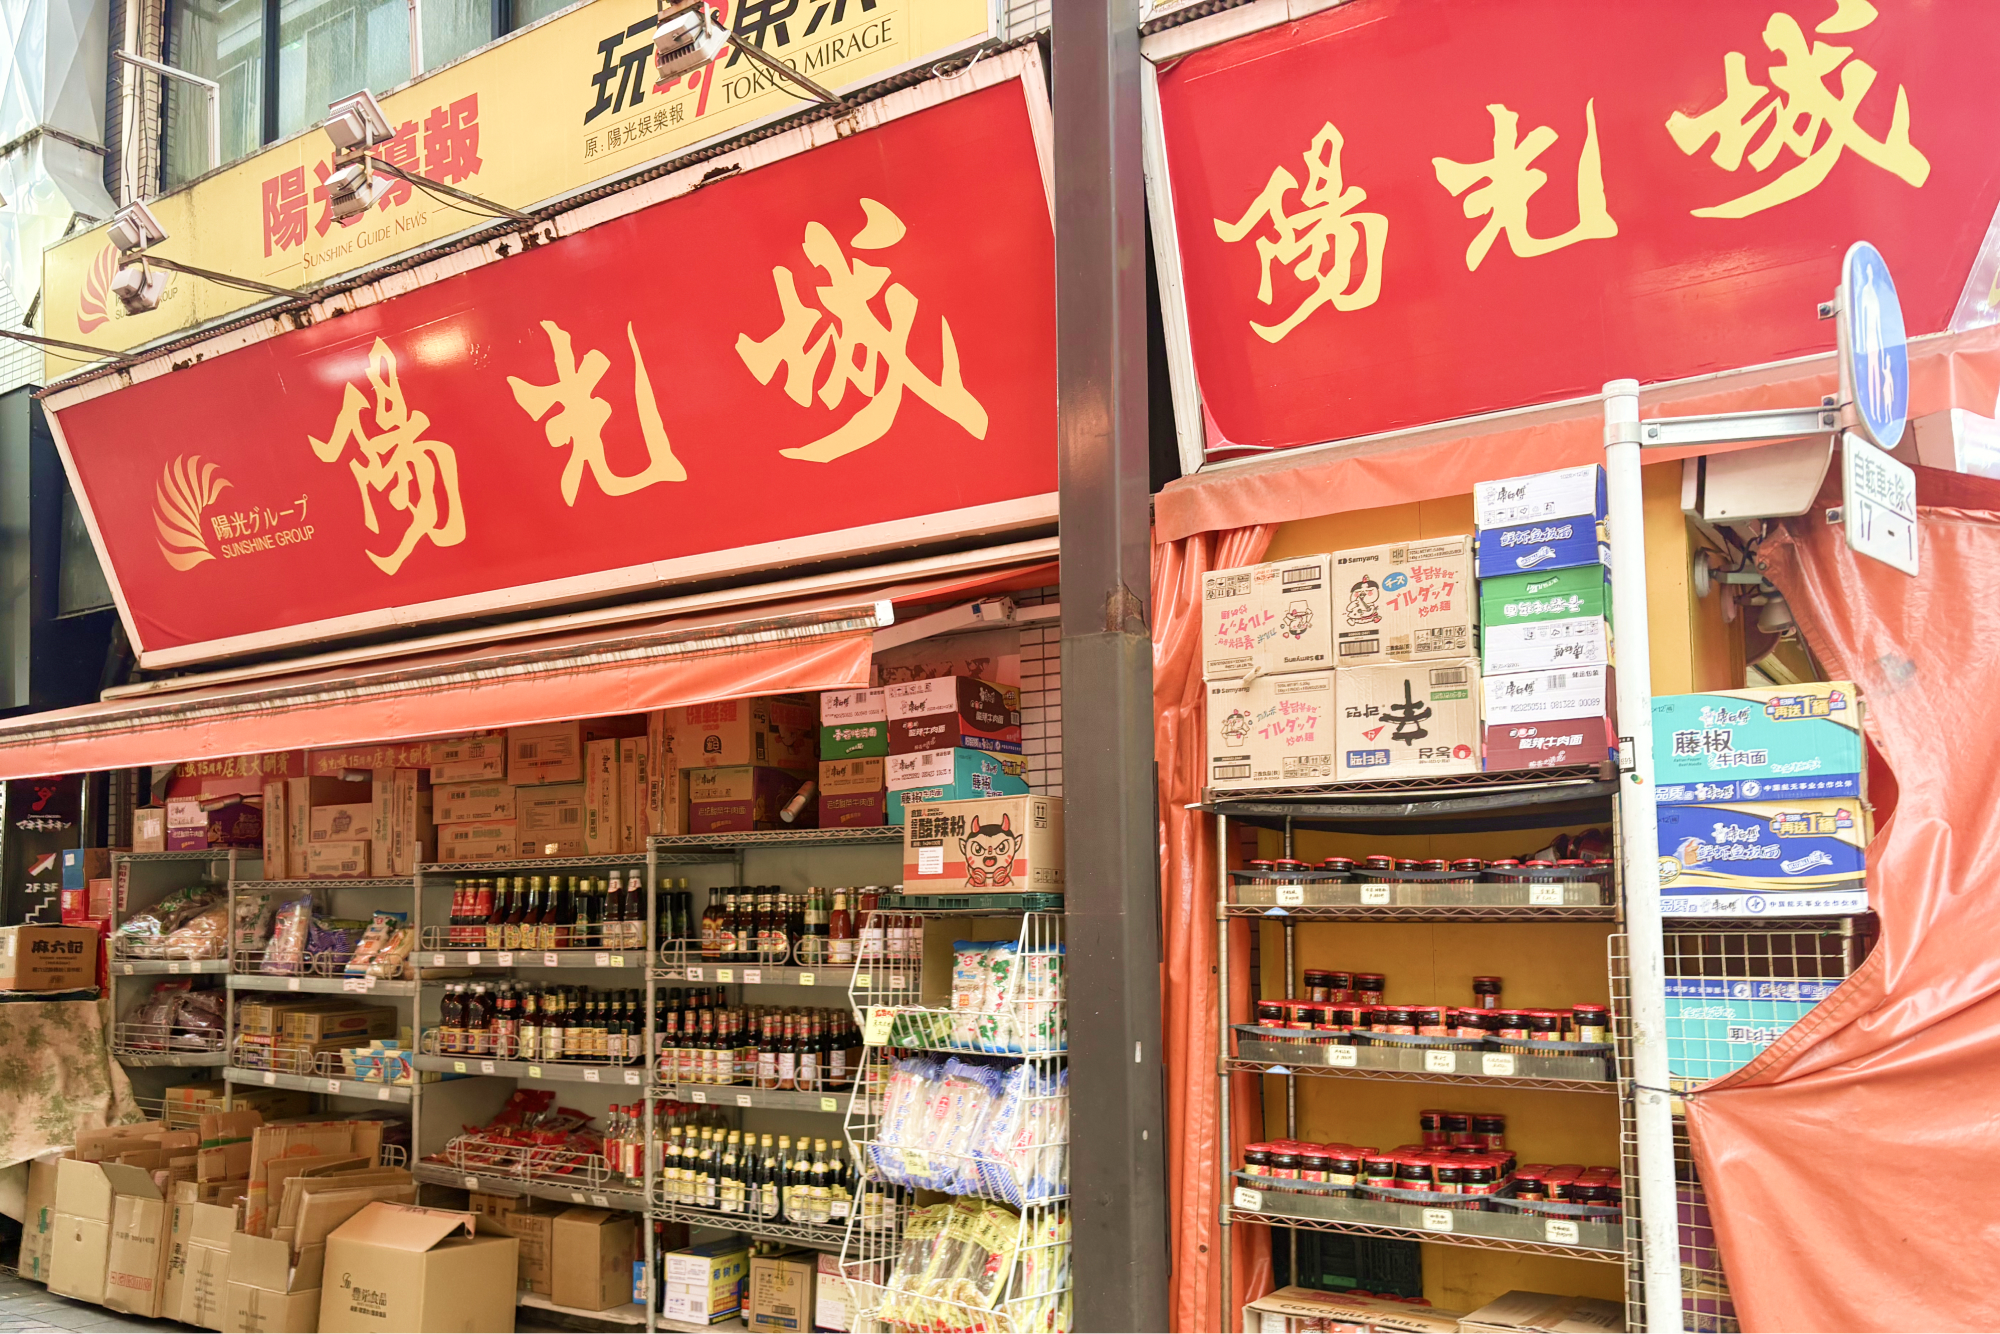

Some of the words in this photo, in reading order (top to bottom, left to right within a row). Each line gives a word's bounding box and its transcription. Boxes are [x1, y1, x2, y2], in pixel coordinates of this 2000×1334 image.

[722, 57, 797, 104] TOKYO
[803, 18, 893, 74] MIRAGE
[1213, 0, 1931, 343] 陽光城
[303, 240, 354, 269] SUNSHINE
[357, 226, 391, 249] GUIDE
[395, 210, 428, 235] NEWS
[308, 196, 990, 576] 陽光城
[210, 493, 309, 542] 陽光グループ
[221, 534, 276, 559] SUNSHINE
[276, 525, 315, 547] GROUP
[1348, 555, 1379, 564] Samyang
[1385, 575, 1406, 589] チーズ
[1386, 582, 1455, 612] ブルダック
[1218, 610, 1275, 636] ブルダック
[1284, 655, 1314, 664] Samyang
[1345, 703, 1380, 719] 라면
[1378, 679, 1432, 747] 辛
[1258, 715, 1318, 740] ブルダック
[1419, 746, 1451, 759] 농심
[1518, 733, 1584, 750] 酸辣牛肉面
[1673, 729, 1734, 756] 藤椒
[1716, 750, 1767, 767] 牛肉面
[918, 815, 966, 839] 酸辣粉
[25, 883, 41, 893] 2F
[43, 882, 59, 893] 3F
[31, 940, 84, 953] 麻六記
[1279, 1303, 1374, 1321] COCONUT
[1378, 1316, 1431, 1329] MILK
